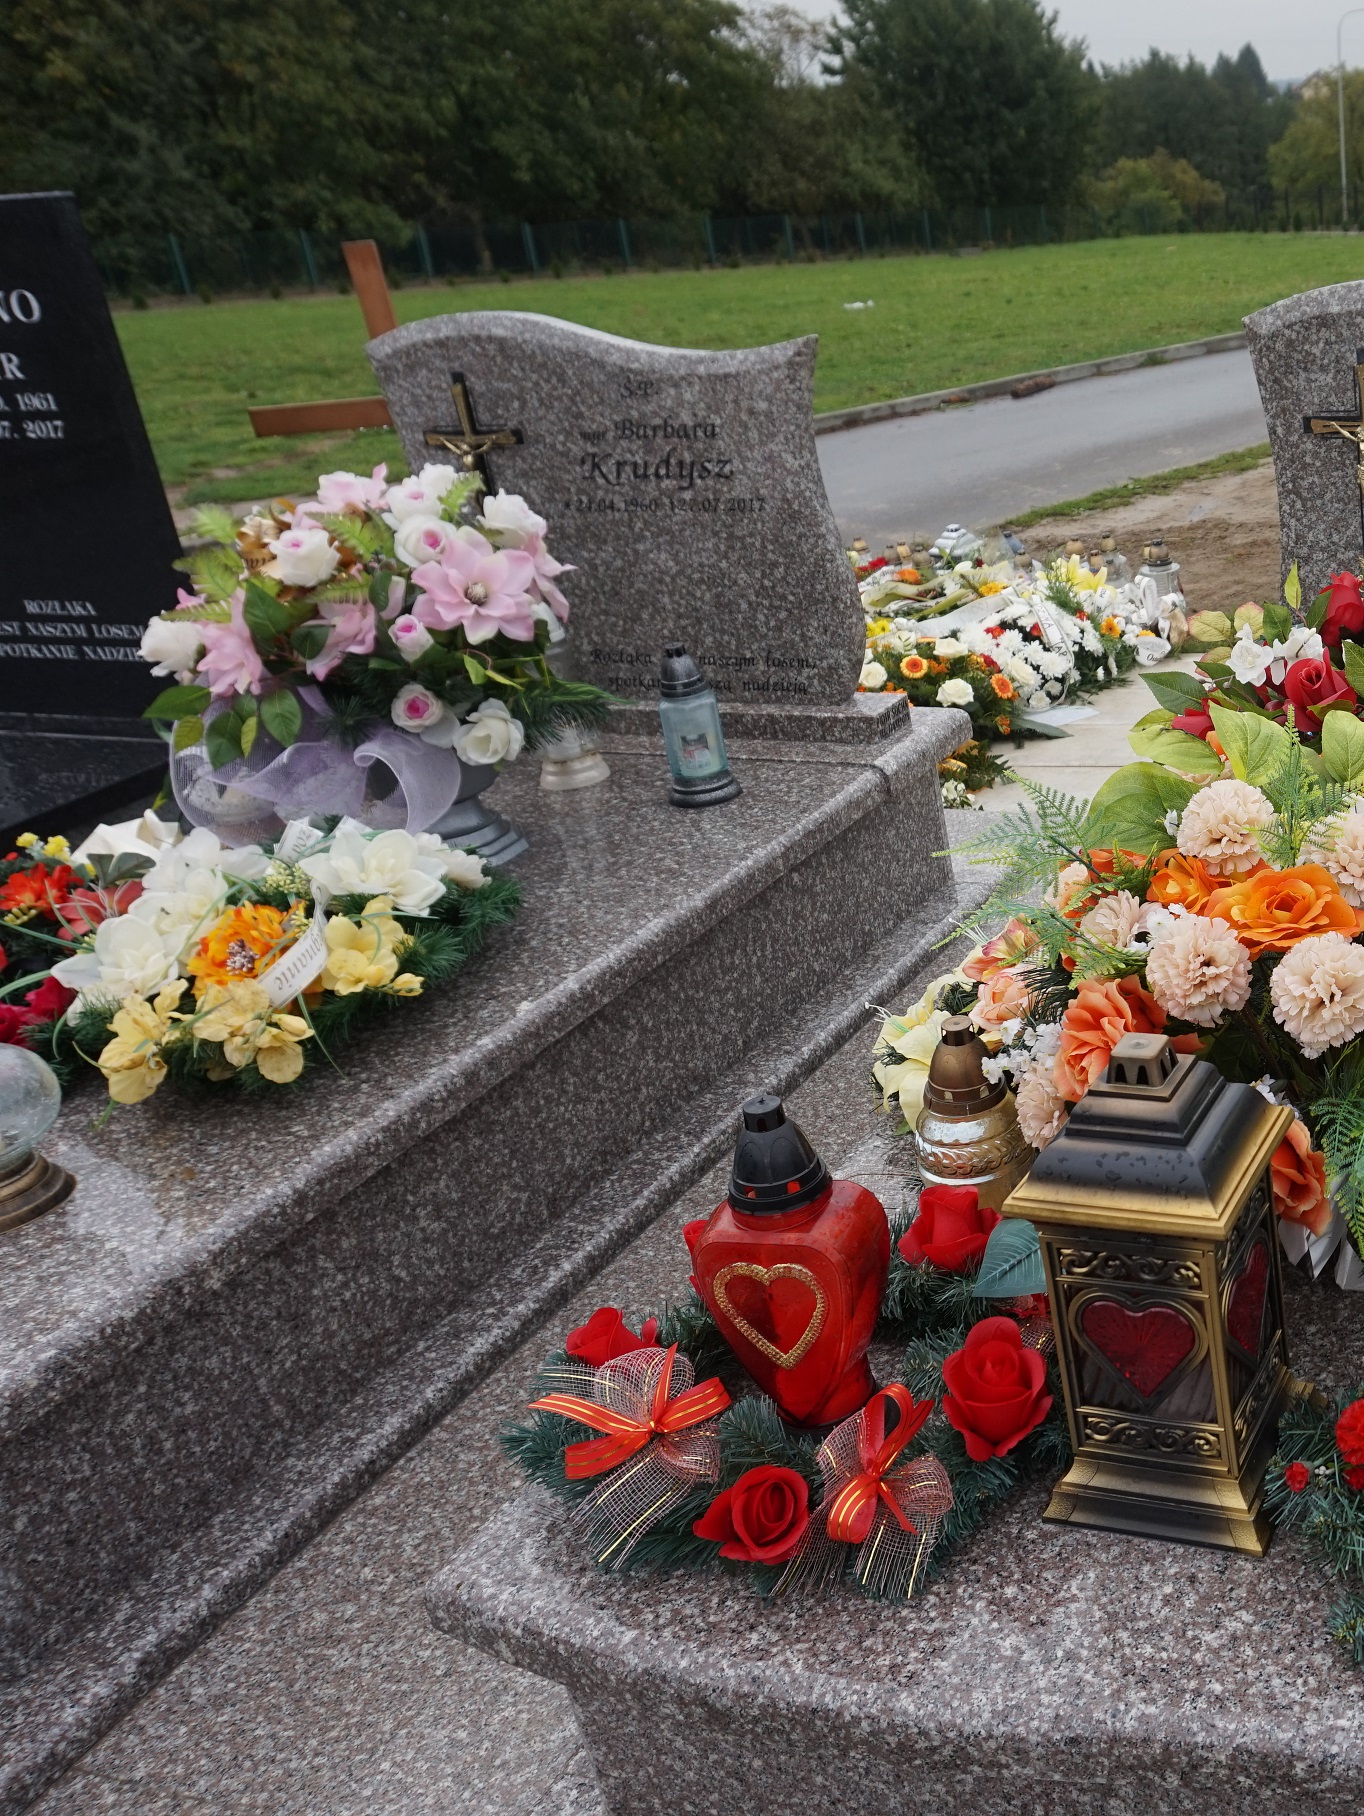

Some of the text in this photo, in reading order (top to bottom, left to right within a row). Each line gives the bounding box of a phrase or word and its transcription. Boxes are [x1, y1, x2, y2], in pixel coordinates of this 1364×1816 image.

[615, 414, 719, 440] Barbara
[580, 447, 734, 490] Krudysz
[0, 643, 80, 660] POTKANIE
